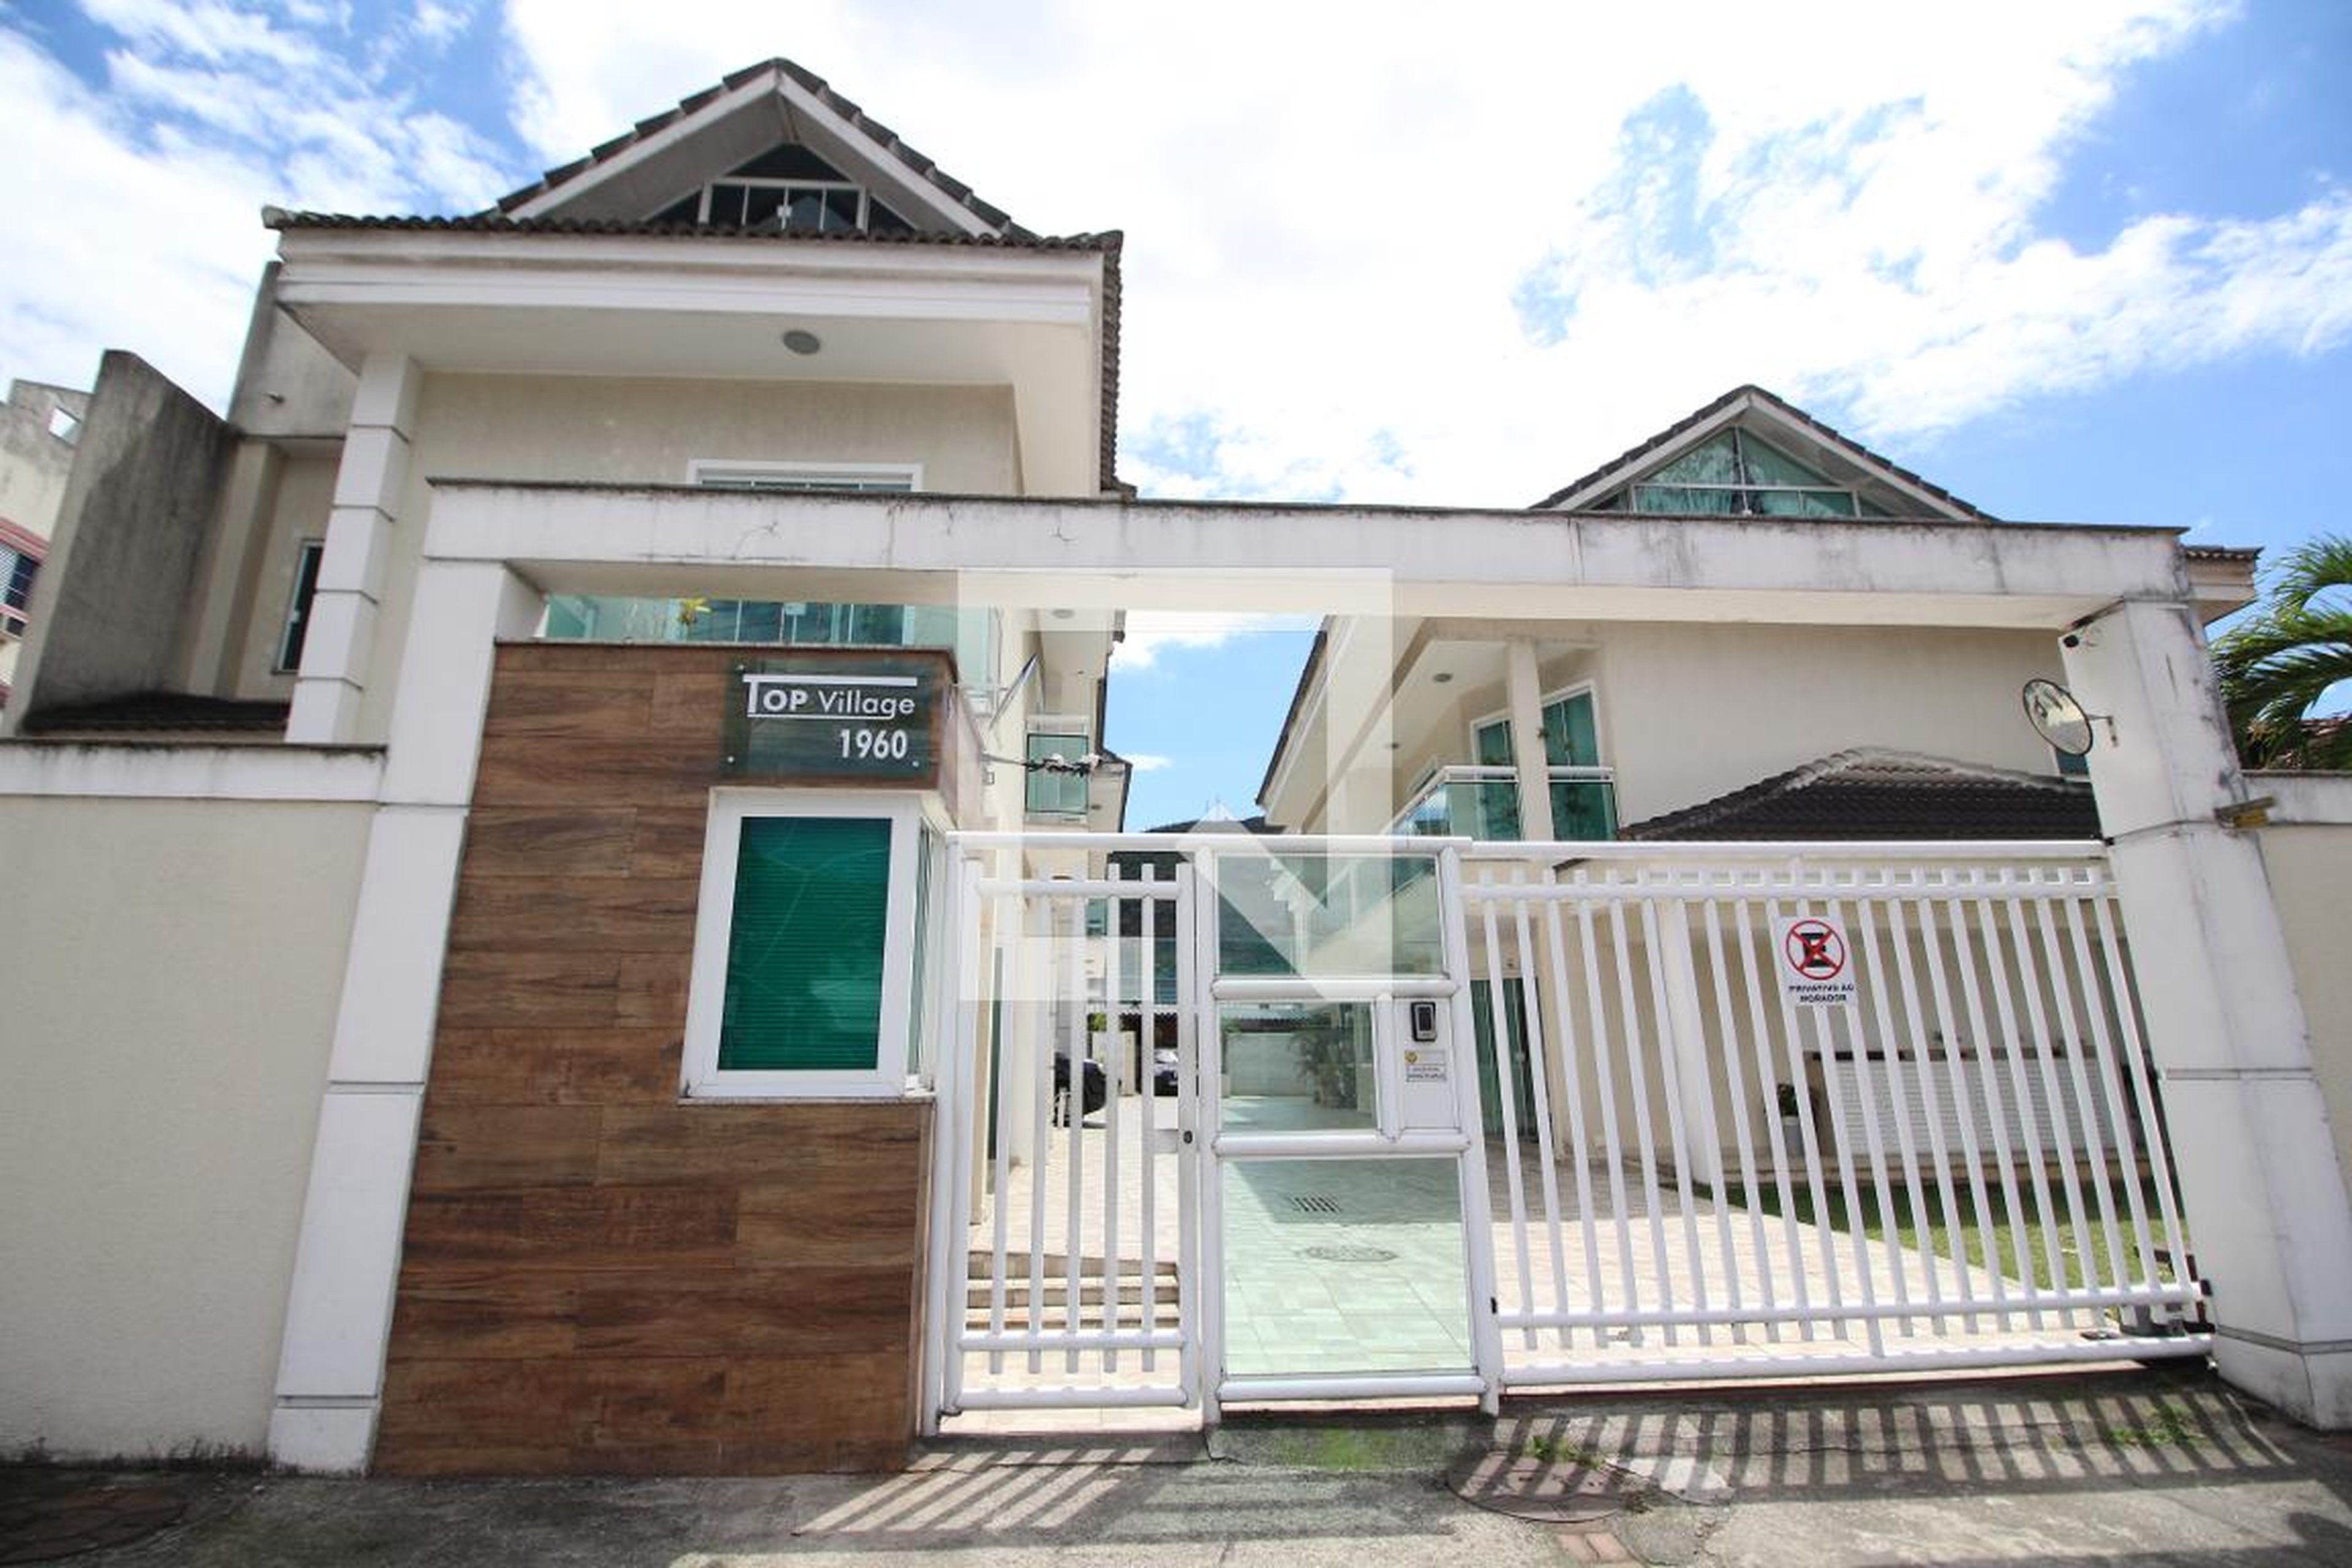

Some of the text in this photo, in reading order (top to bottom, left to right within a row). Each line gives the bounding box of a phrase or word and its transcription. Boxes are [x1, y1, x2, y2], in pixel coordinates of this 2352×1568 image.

[743, 674, 915, 718] TOP Village
[839, 729, 908, 759] 1960
[1800, 993, 1846, 1002] MORADOR
